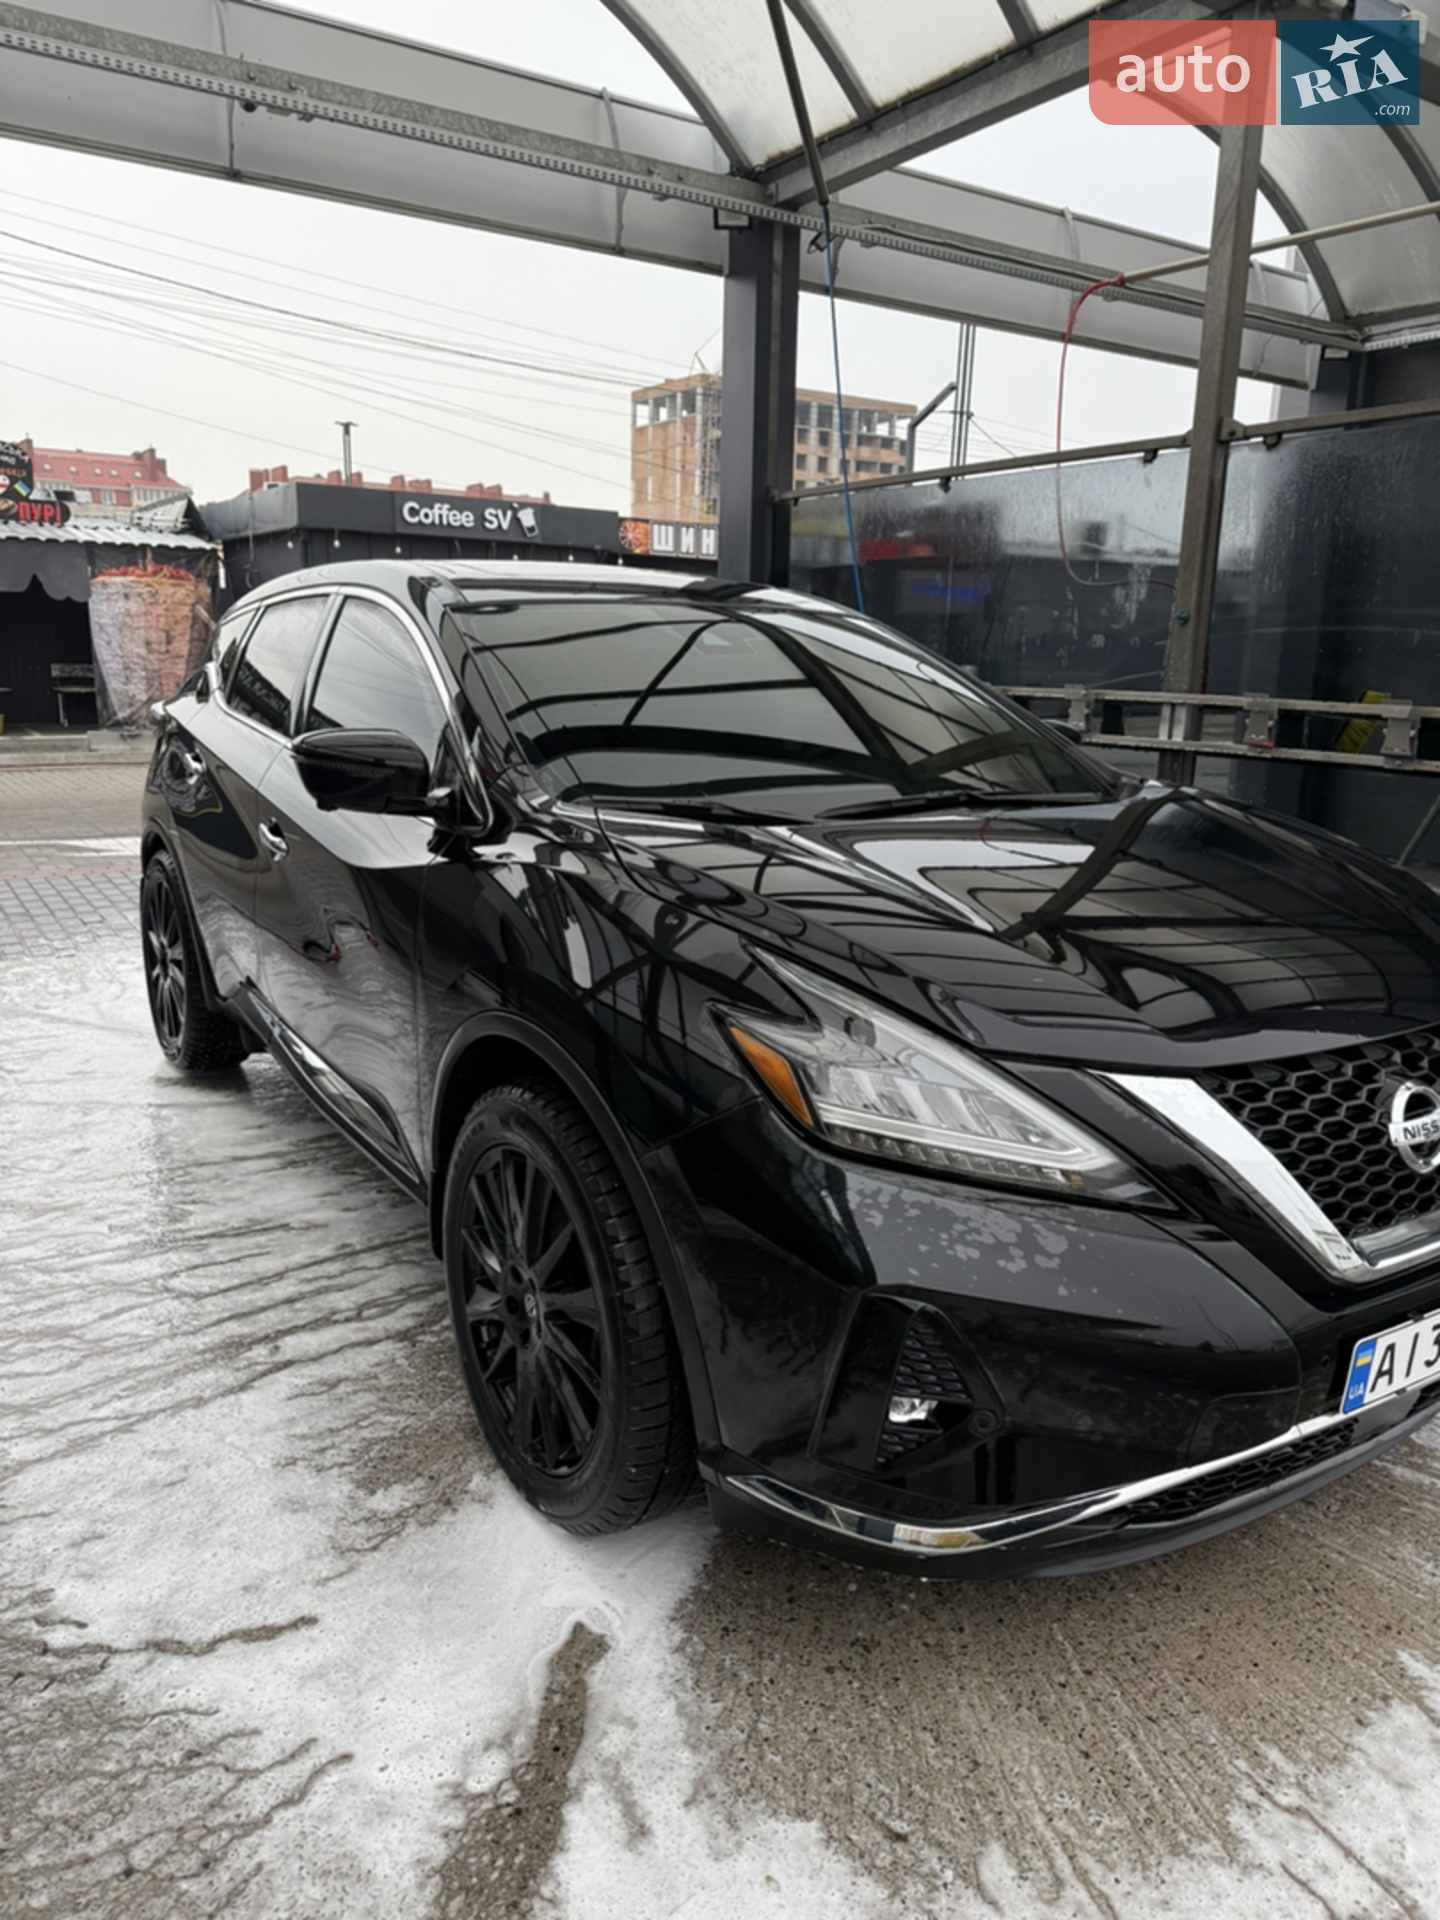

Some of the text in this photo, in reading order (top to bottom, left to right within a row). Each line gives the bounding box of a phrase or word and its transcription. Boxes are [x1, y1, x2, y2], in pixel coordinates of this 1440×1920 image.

[402, 501, 512, 530] Coffee SV
[652, 523, 716, 555] ШИН
[1348, 1382, 1365, 1400] UA
